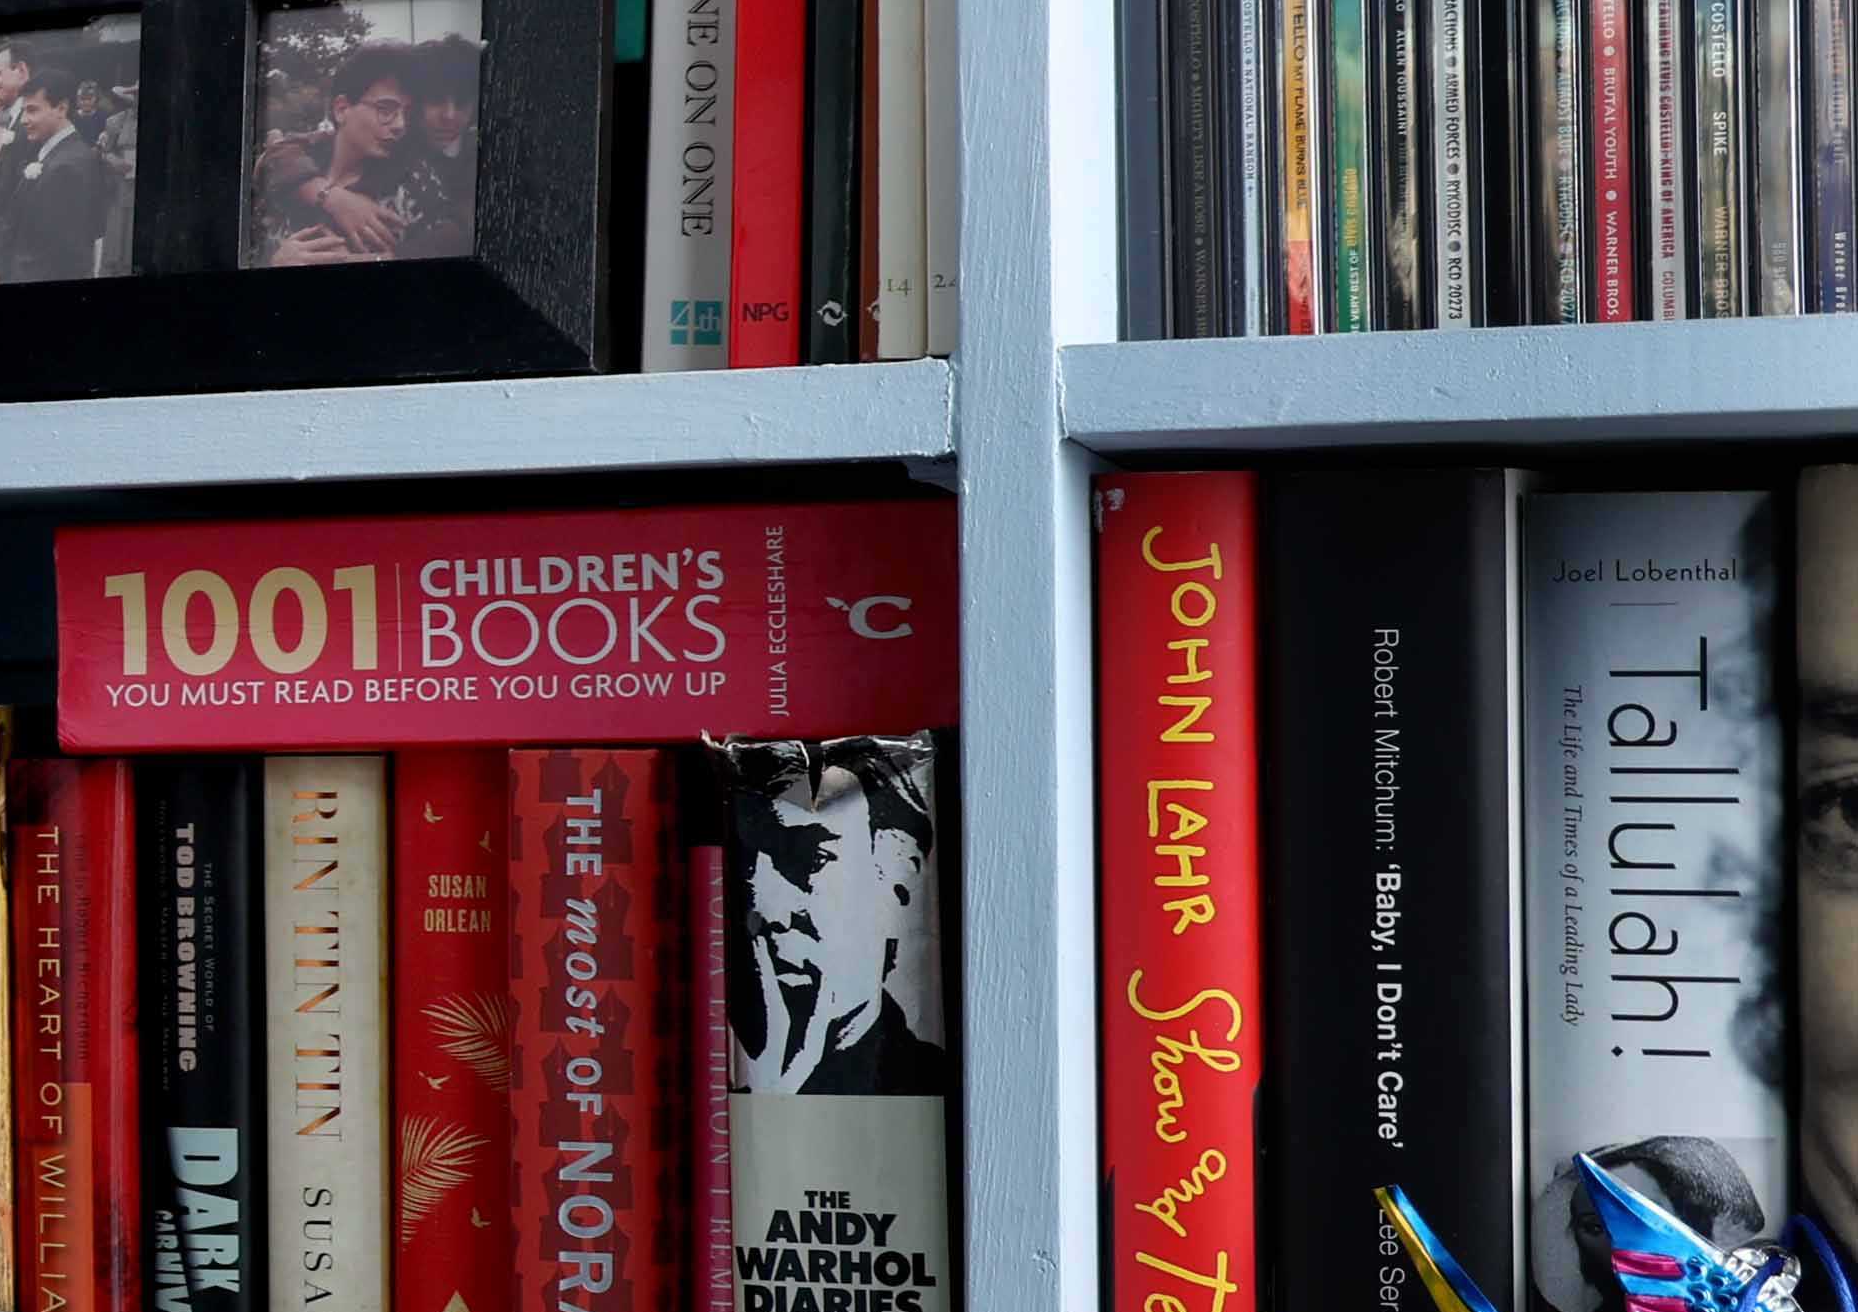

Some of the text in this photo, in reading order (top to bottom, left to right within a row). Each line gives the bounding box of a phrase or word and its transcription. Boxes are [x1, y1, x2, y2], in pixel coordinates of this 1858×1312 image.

[1710, 1, 1726, 77] COSTELLO
[685, 61, 718, 127] ON
[1603, 67, 1618, 182] BRUTAL YOUTH
[1713, 111, 1728, 156] SPIKE
[681, 143, 714, 236] ONE
[1605, 211, 1618, 278] WARNER
[742, 303, 789, 321] NPG
[419, 549, 724, 597] CHILDREN'S
[1552, 559, 1737, 584] Joel Lobenthal
[104, 565, 380, 676] 1001
[419, 596, 727, 668] BOOKS
[766, 526, 788, 717] JULIA ECCLESHARE
[106, 672, 725, 707] YOU MUST READ BEFORE YOU GROW UP
[1372, 629, 1400, 717] Robert
[1141, 526, 1222, 935] JOHN LAHR
[1375, 728, 1399, 851] Mitchum:
[37, 826, 60, 904] THE
[292, 791, 338, 897] RIN
[566, 790, 601, 875] THE
[1607, 636, 1741, 1059] Tallulah!
[425, 909, 491, 933] ORLEAN
[428, 875, 486, 897] SUSAN
[39, 928, 61, 1061] HEART
[293, 912, 340, 1014] TIN
[565, 899, 597, 1038] most
[1127, 969, 1241, 1143] Show
[1378, 982, 1403, 1062] Don't
[41, 1083, 62, 1136] OF
[295, 1035, 341, 1142] TIN
[566, 1060, 602, 1115] OF
[169, 1128, 240, 1293] DARK
[765, 1211, 896, 1246] ANDY
[805, 1190, 850, 1209] THE
[1136, 1148, 1227, 1237] and
[736, 1246, 936, 1287] WARHOL
